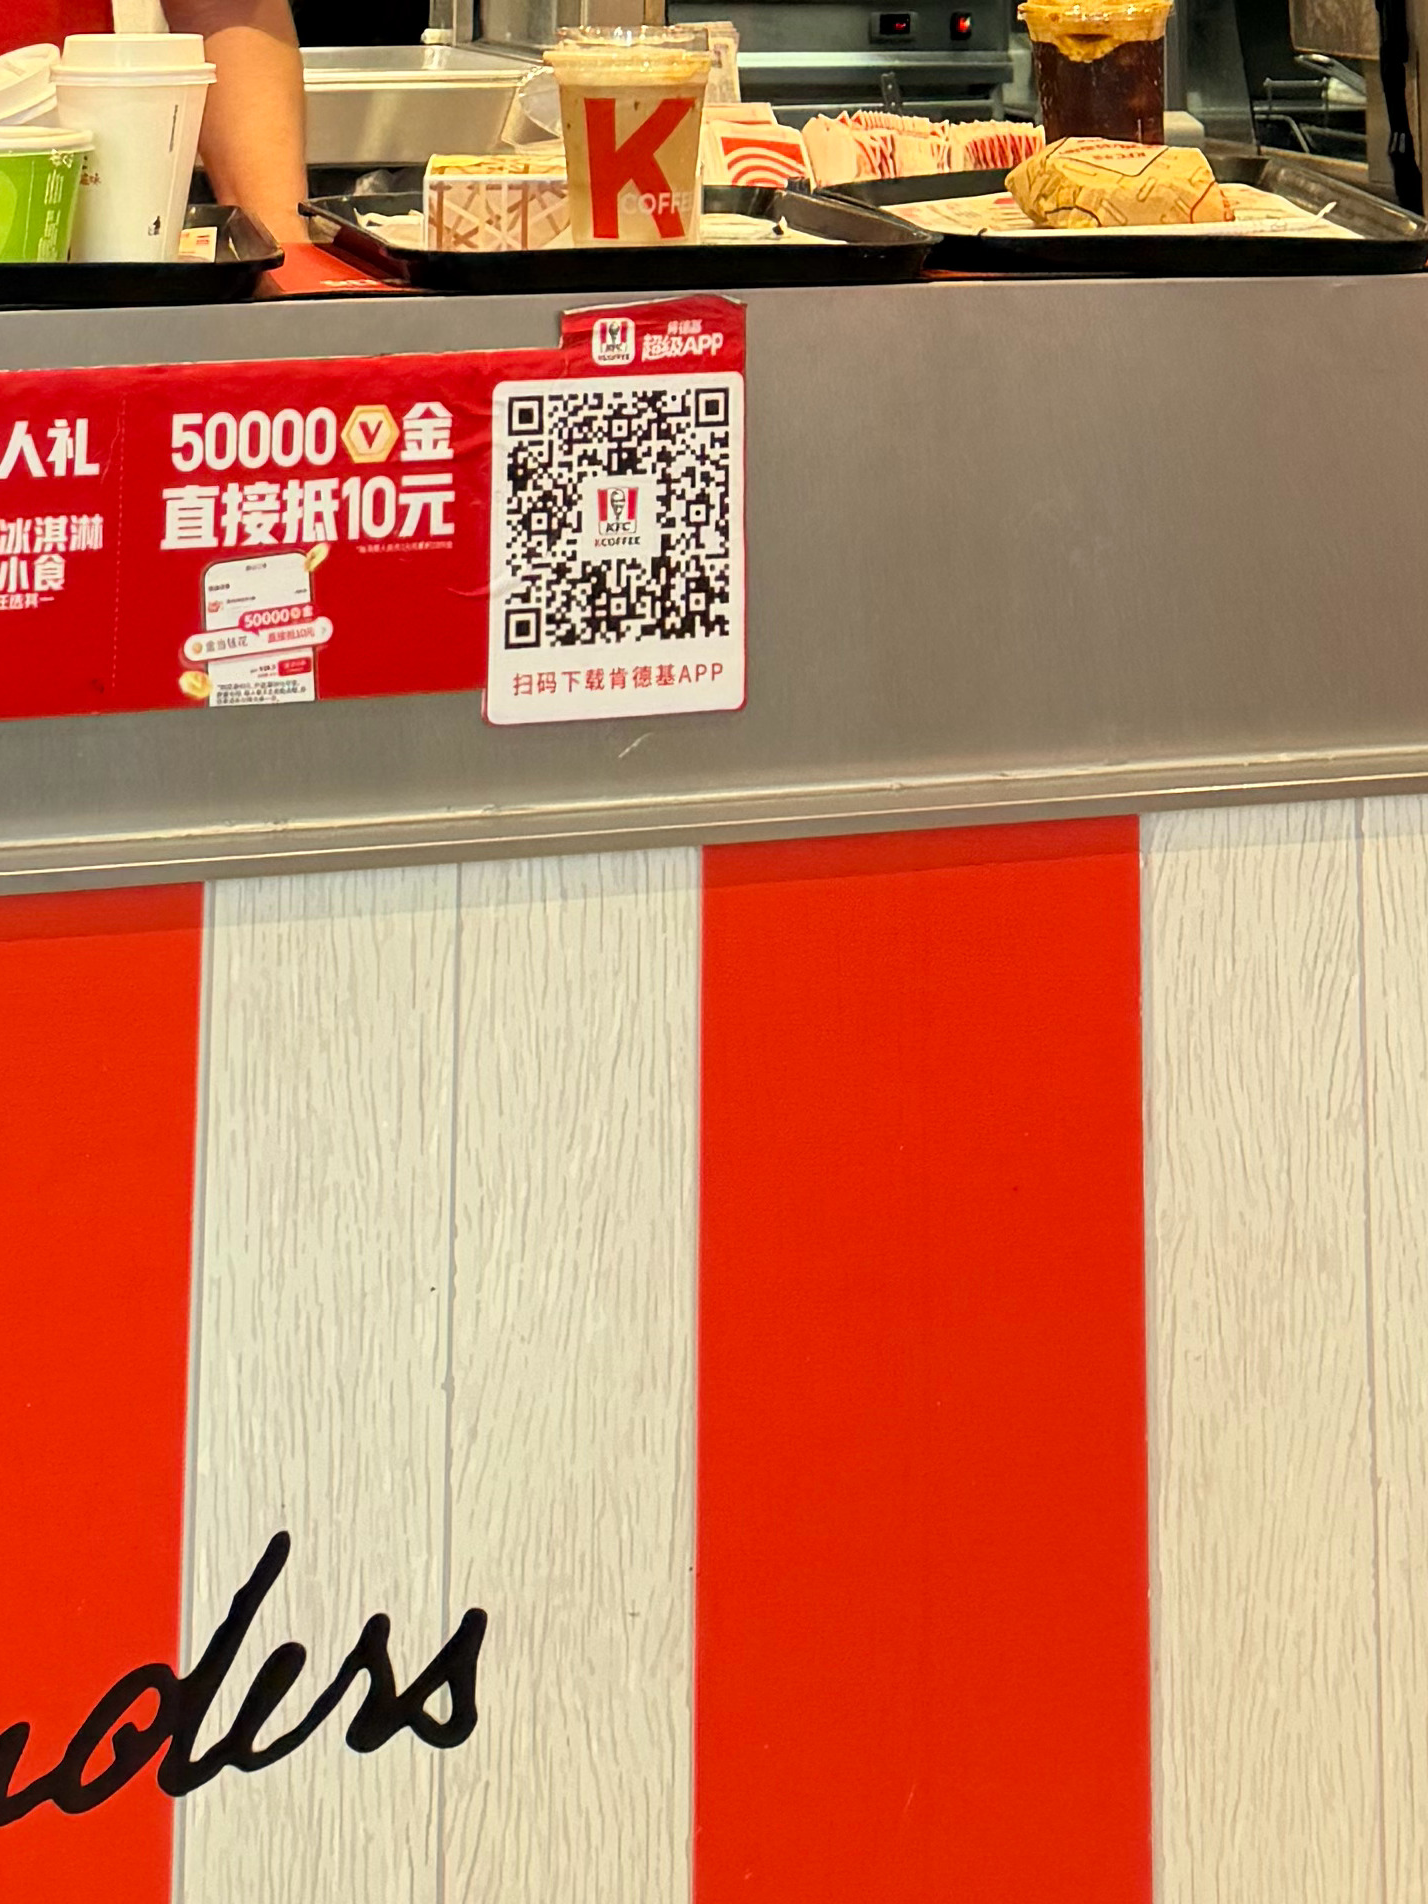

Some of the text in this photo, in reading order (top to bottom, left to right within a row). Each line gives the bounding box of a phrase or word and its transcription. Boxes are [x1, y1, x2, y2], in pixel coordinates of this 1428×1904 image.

[584, 97, 697, 239] K
[171, 402, 454, 472] 50000 金
[160, 473, 455, 551] 直接抵10元
[513, 663, 724, 696] 扫码下载肯德基APP
